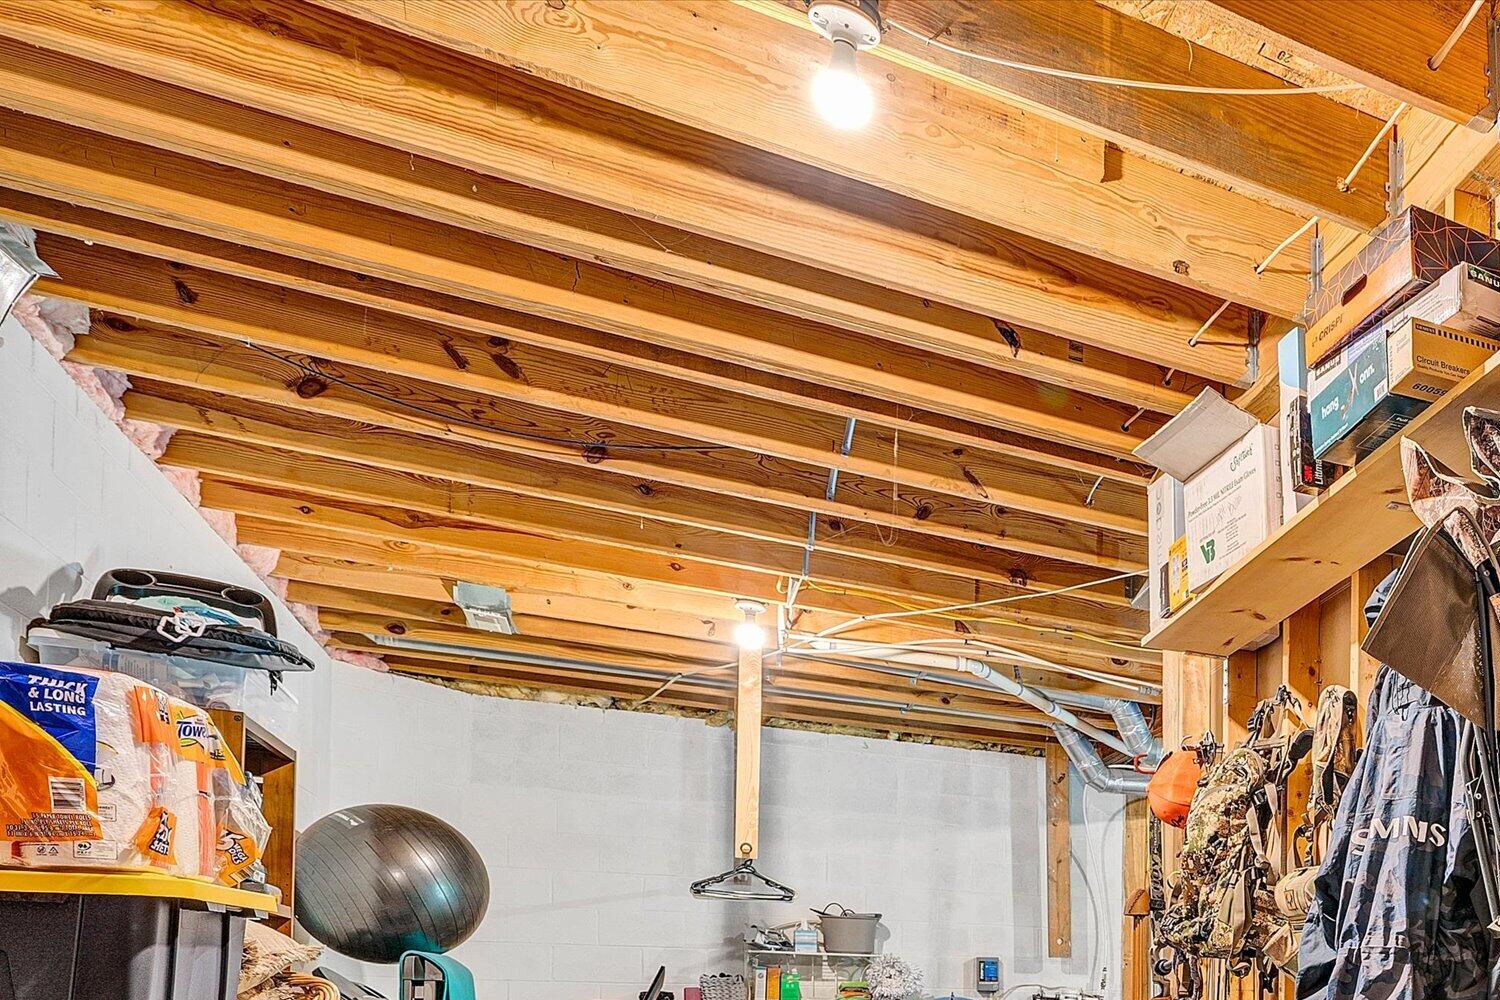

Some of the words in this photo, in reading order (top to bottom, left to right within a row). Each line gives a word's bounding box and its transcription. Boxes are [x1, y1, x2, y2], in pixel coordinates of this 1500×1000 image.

[1469, 268, 1500, 288] SANU
[1318, 313, 1344, 342] CRISPI
[1416, 355, 1439, 368] Circuit
[1440, 359, 1471, 376] Breakers
[1321, 396, 1340, 420] hang
[1303, 463, 1314, 484] 3M
[1314, 459, 1324, 486] Littma
[28, 686, 39, 699] &
[44, 688, 86, 704] LONG
[29, 701, 87, 717] LASTING
